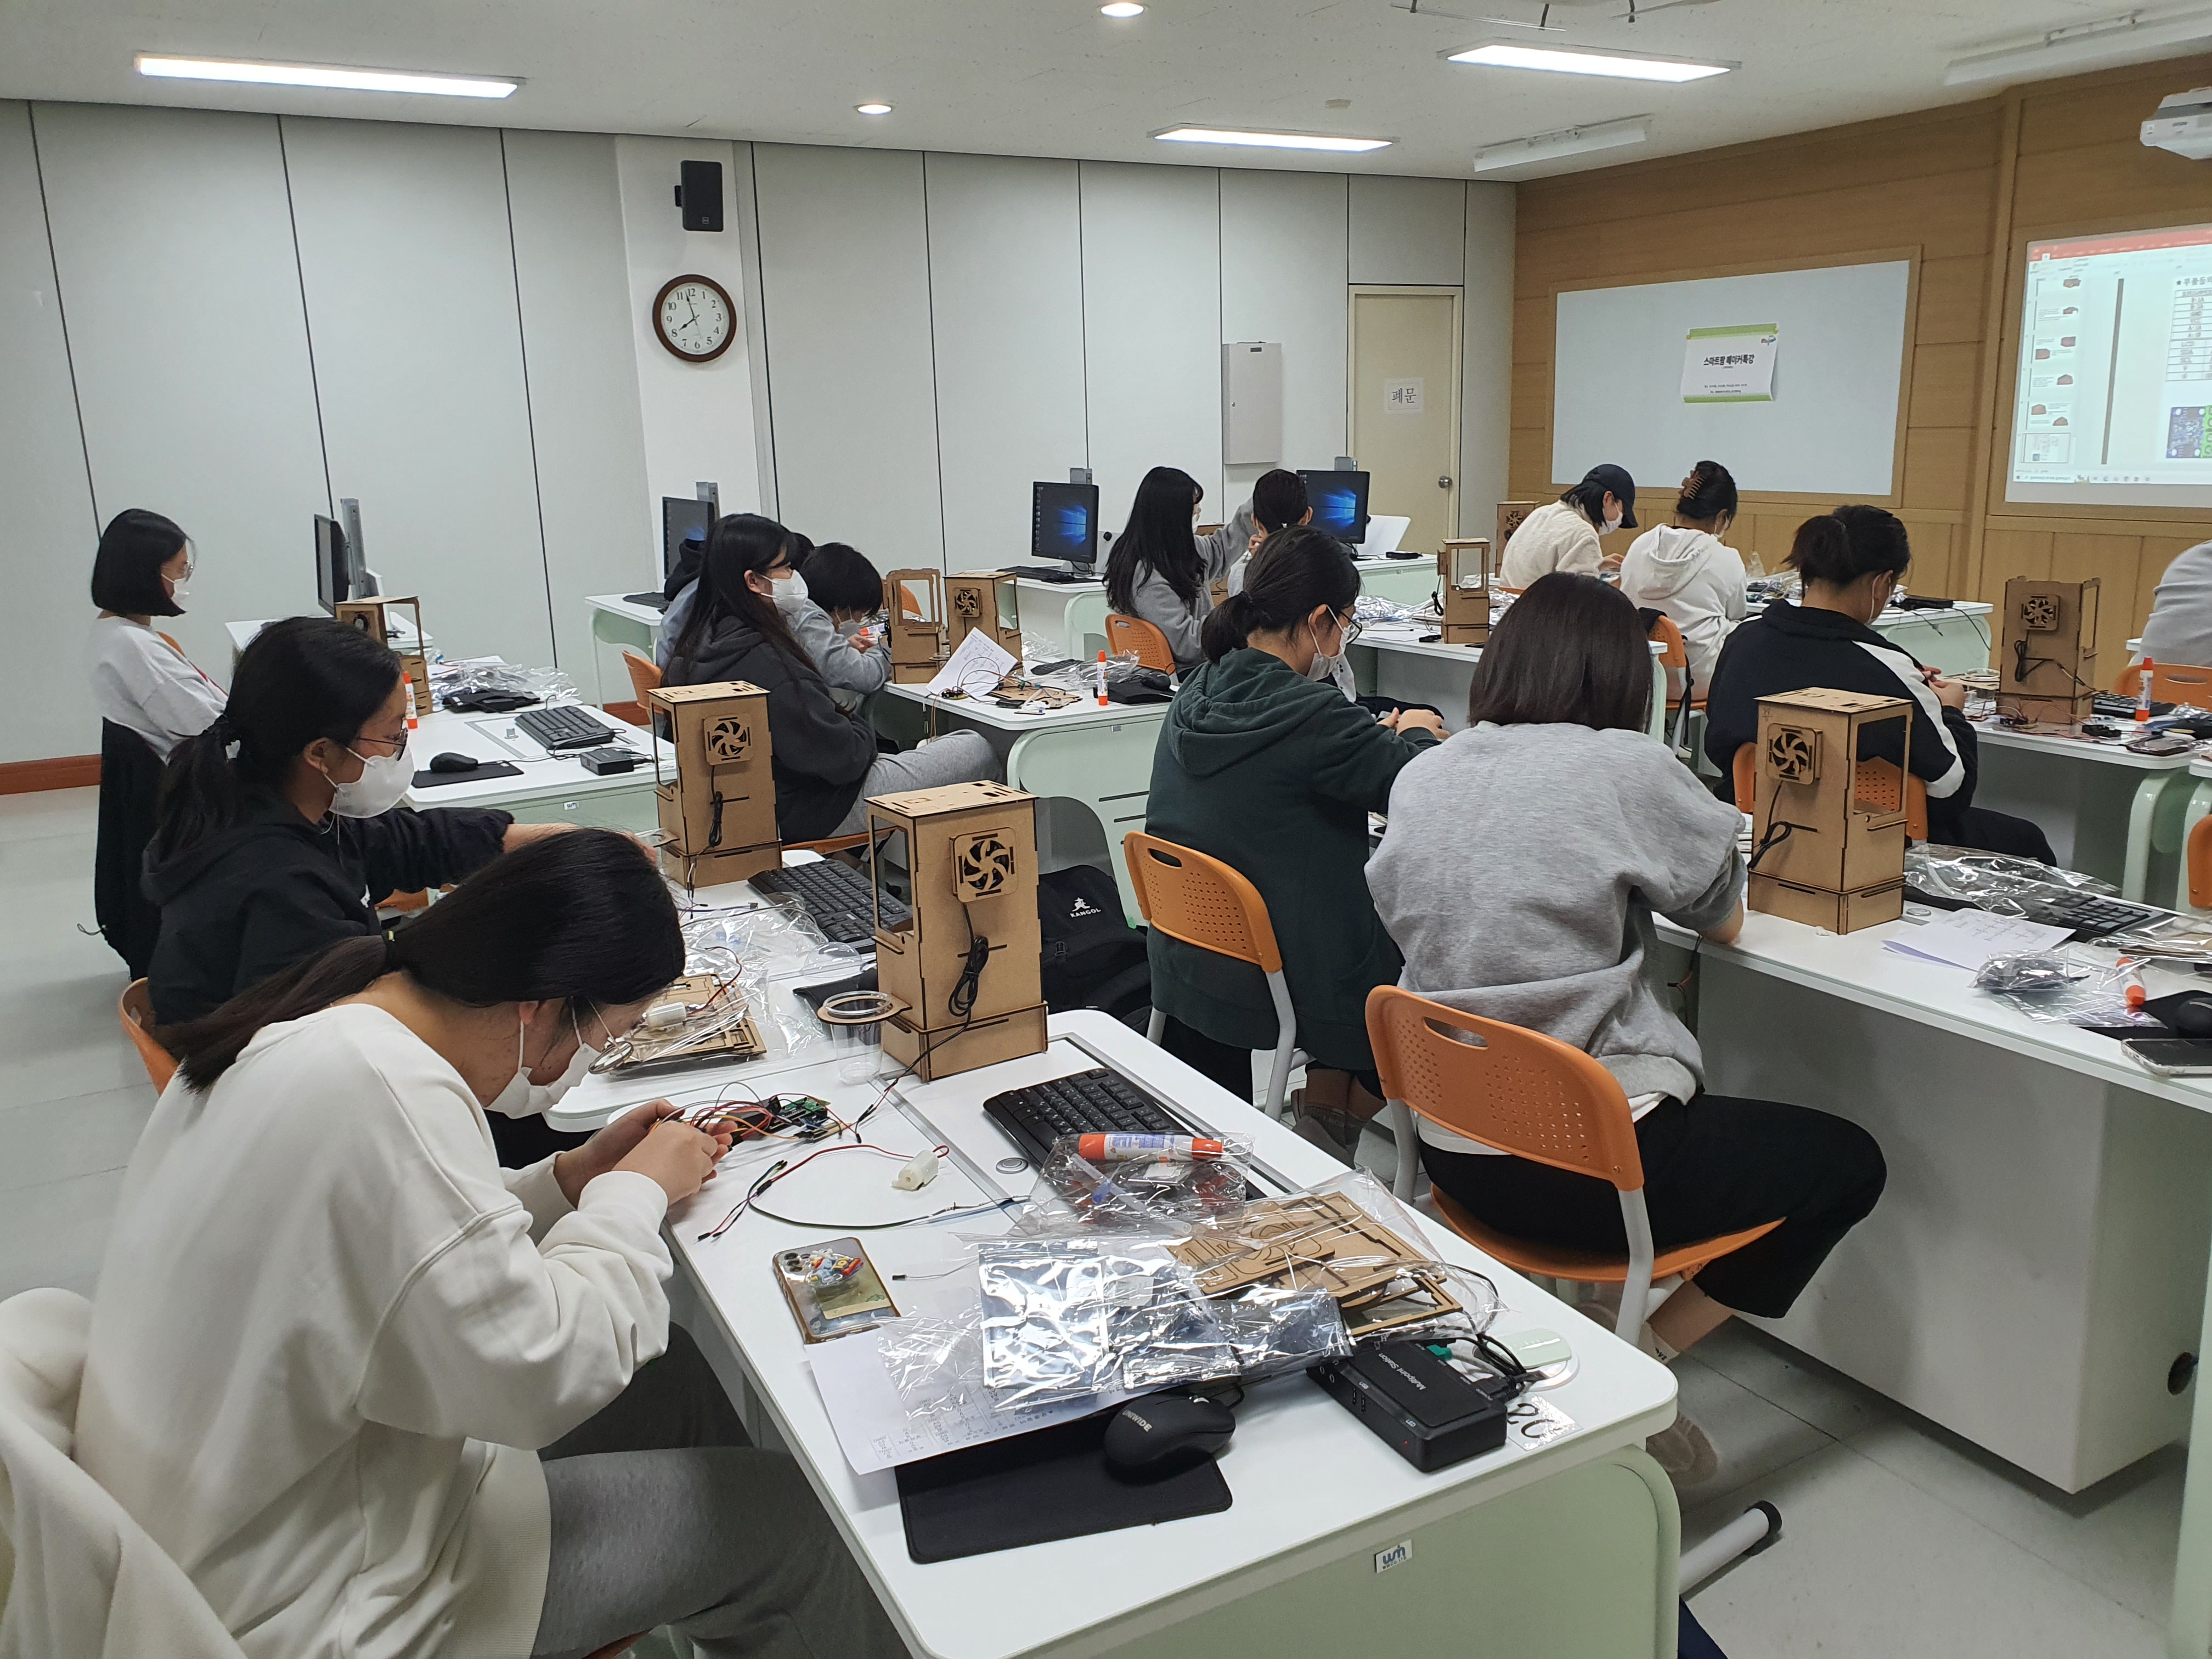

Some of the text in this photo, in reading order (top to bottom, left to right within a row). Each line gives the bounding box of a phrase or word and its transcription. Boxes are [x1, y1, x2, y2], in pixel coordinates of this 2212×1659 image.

[676, 292, 683, 300] 11
[688, 288, 696, 297] 12
[702, 291, 706, 300] 1
[668, 302, 676, 311] 10
[711, 300, 716, 308] 2
[666, 315, 673, 324] 9
[715, 313, 722, 321] 3
[672, 329, 678, 337] 8
[682, 338, 687, 347] 7
[706, 336, 713, 345] 5
[1703, 354, 1755, 366] 스마트팜 메이커특강
[1392, 387, 1417, 404] 폐문
[1070, 908, 1102, 918] KANGOL
[1378, 1353, 1426, 1390] Multipoint Station
[1122, 1409, 1153, 1432] UNIWIDE
